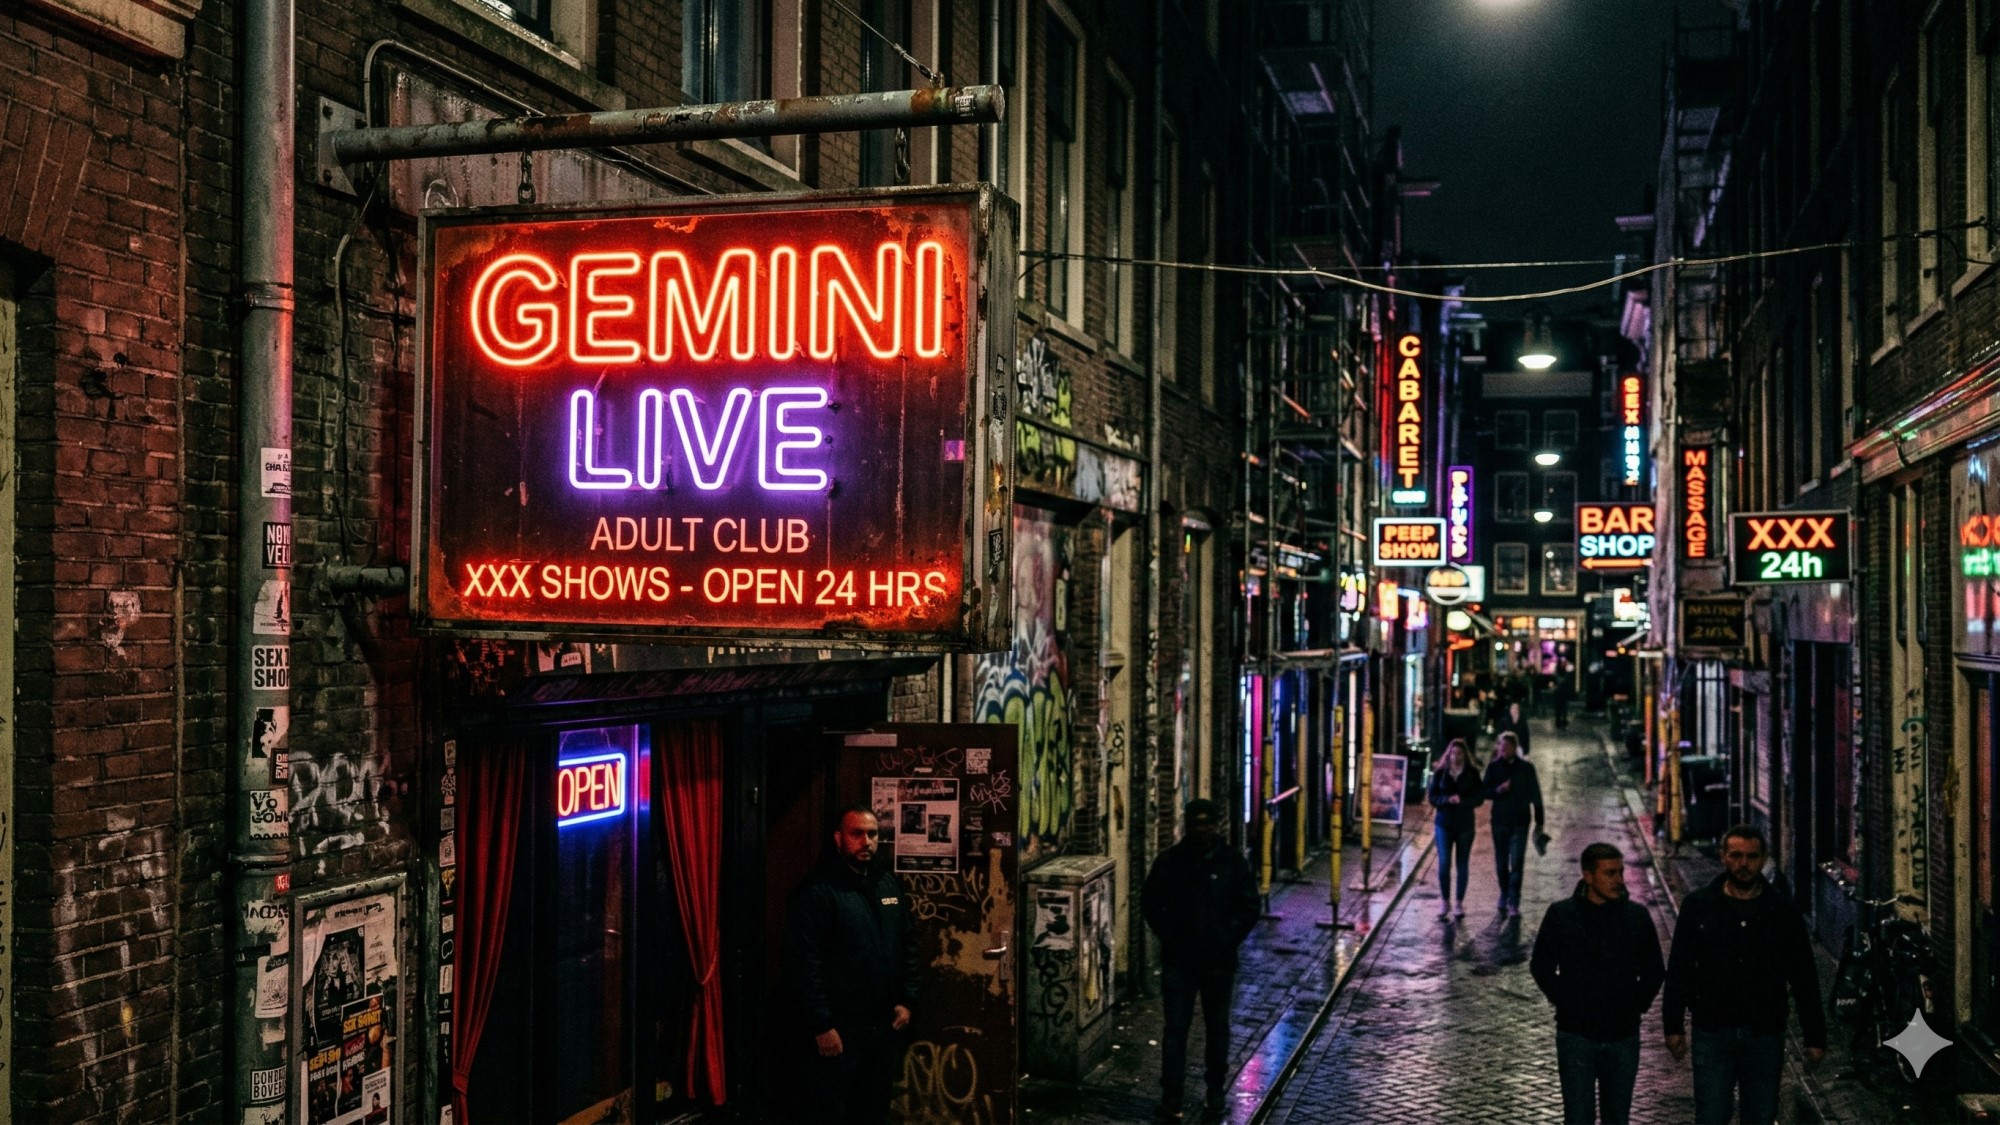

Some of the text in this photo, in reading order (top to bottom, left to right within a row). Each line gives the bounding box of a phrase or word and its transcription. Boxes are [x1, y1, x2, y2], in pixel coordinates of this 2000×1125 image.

[470, 241, 944, 367] GEMINI
[1398, 335, 1421, 488] CABARET
[568, 387, 828, 491] LIVE
[1580, 506, 1655, 534] BAR
[1684, 449, 1707, 558] MASSAGE
[590, 517, 810, 553] ADULT CLUB
[1379, 542, 1440, 559] SHOW
[1384, 525, 1436, 541] PEEP
[1579, 534, 1655, 557] SHOP
[1747, 517, 1835, 550] XXX
[1760, 551, 1823, 579] 24h
[464, 562, 532, 599] XXX
[541, 565, 671, 602] SHOWS
[703, 567, 804, 605] OPEN
[815, 571, 857, 606] 24
[869, 571, 948, 606] HRS
[558, 761, 621, 816] OPEN
